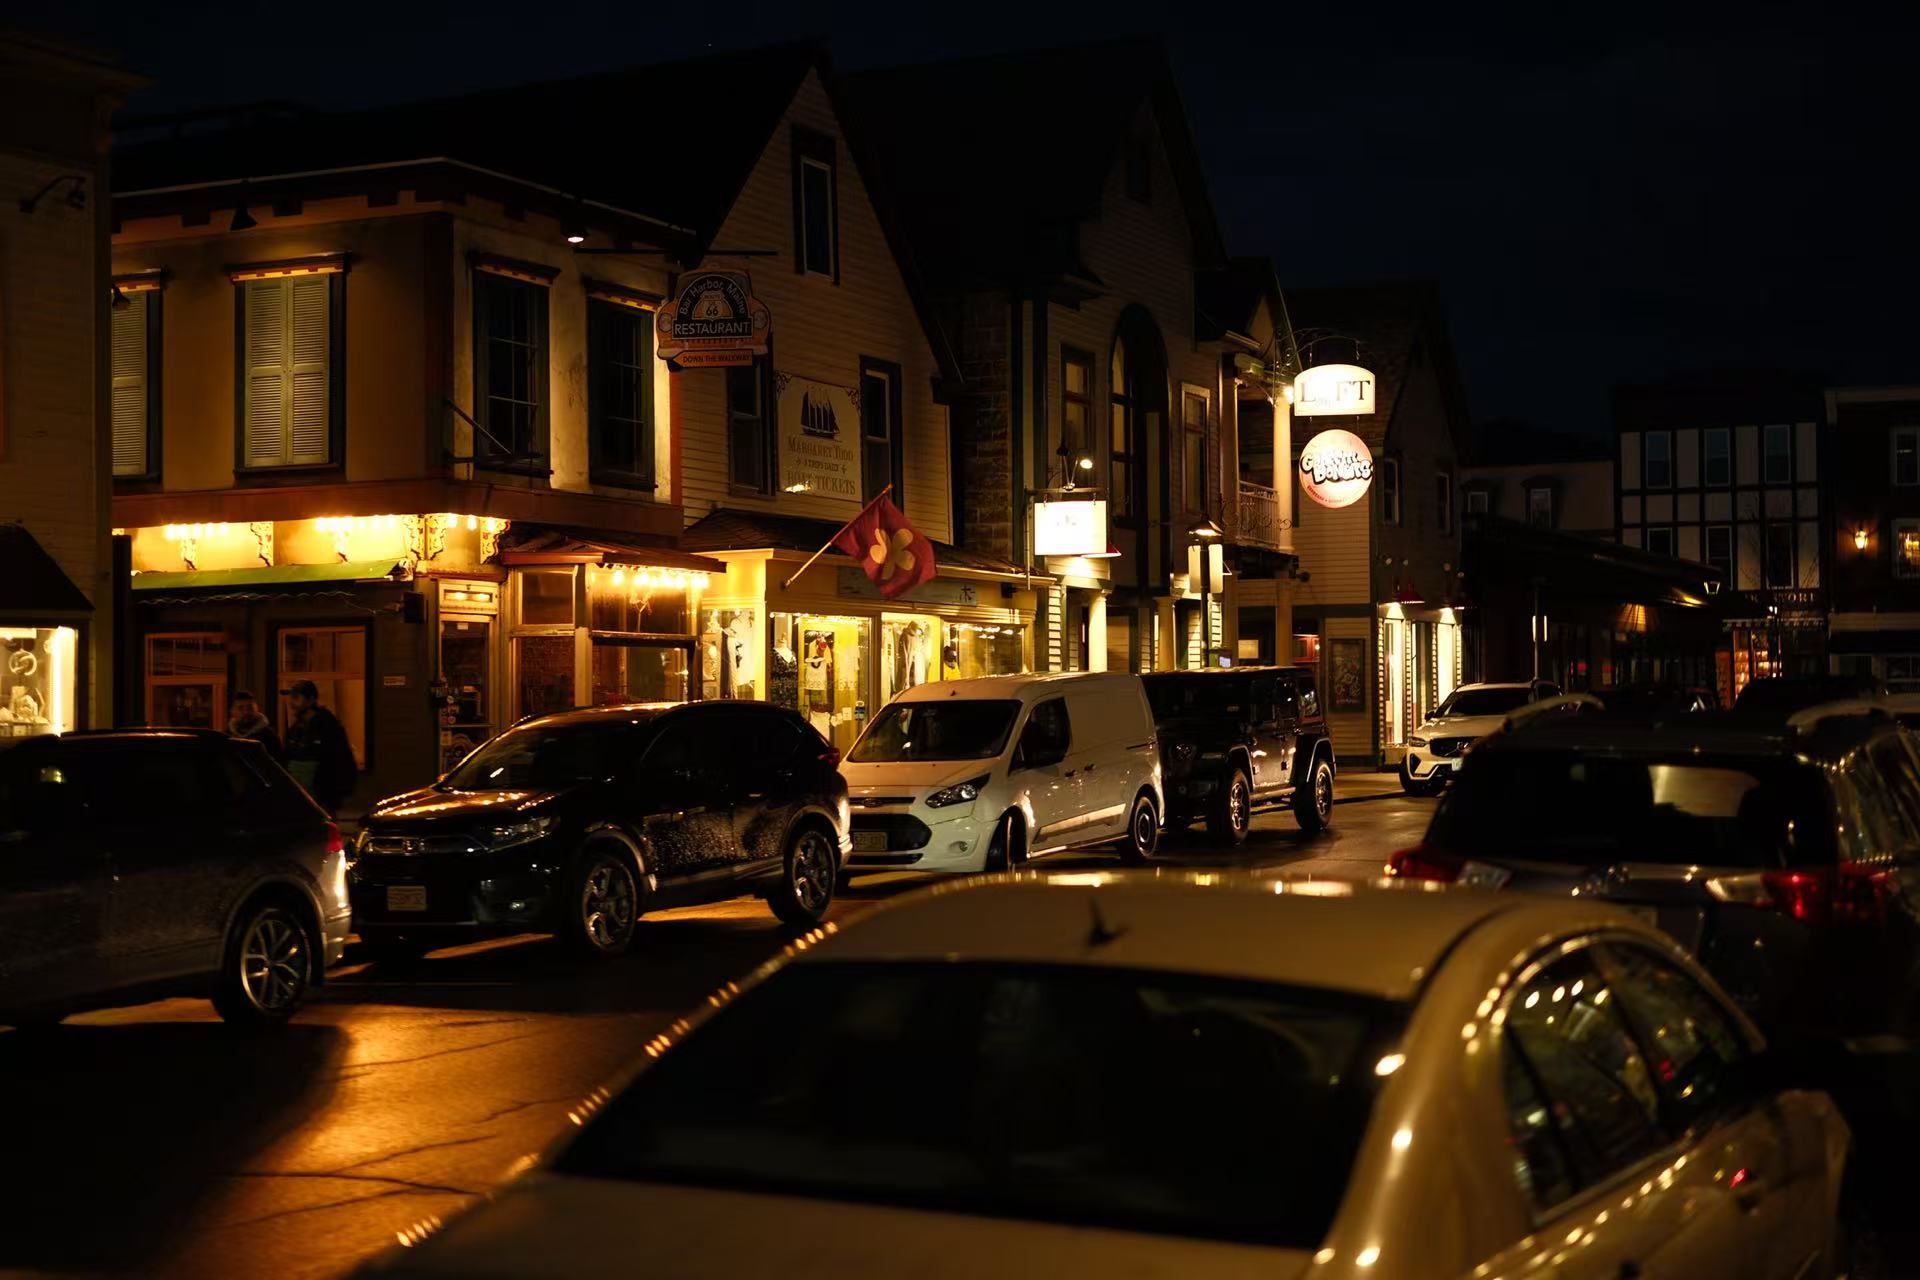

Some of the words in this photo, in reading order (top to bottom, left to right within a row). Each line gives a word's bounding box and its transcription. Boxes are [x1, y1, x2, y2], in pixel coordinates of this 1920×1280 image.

[680, 297, 692, 315] Bar
[691, 279, 724, 297] Harbor,
[727, 284, 746, 314] Maine
[706, 305, 719, 316] 66
[674, 322, 750, 335] RESTAURANT
[683, 355, 704, 363] DOWN
[1300, 380, 1371, 402] LFT
[788, 436, 832, 457] MARGARET
[833, 444, 854, 462] TODD
[824, 462, 839, 472] DAILY
[815, 475, 856, 495] TICKETS
